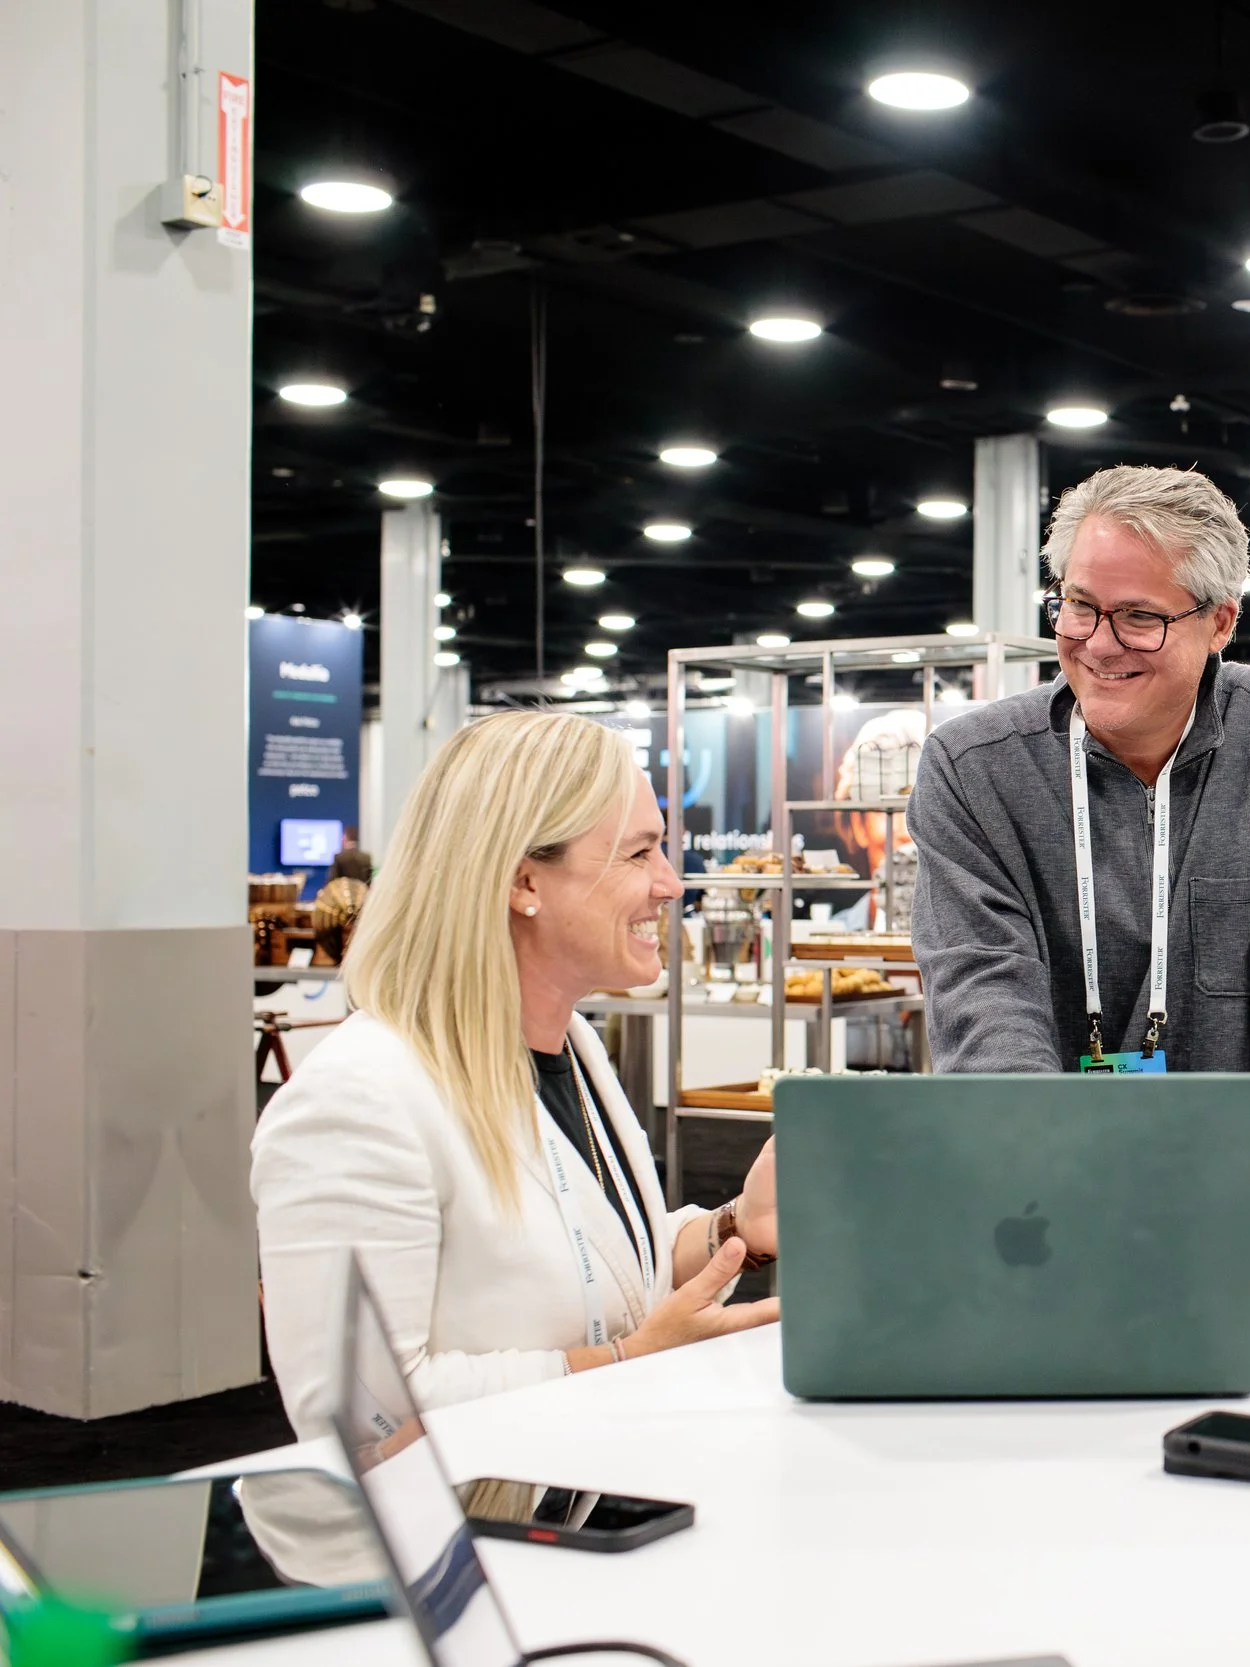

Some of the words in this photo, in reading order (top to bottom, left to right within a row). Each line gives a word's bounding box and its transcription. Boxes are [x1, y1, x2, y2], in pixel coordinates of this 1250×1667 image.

[1073, 737, 1082, 779] FORRESTER
[1077, 806, 1086, 849] FORRESTER
[1158, 803, 1167, 847] FORRESTER
[1081, 876, 1090, 920] FORRESTER
[1156, 874, 1166, 918] FORRESTER
[1086, 948, 1095, 992] FORRESTER
[1154, 947, 1164, 991] FORRESTER
[573, 1227, 595, 1284] FORRESTER
